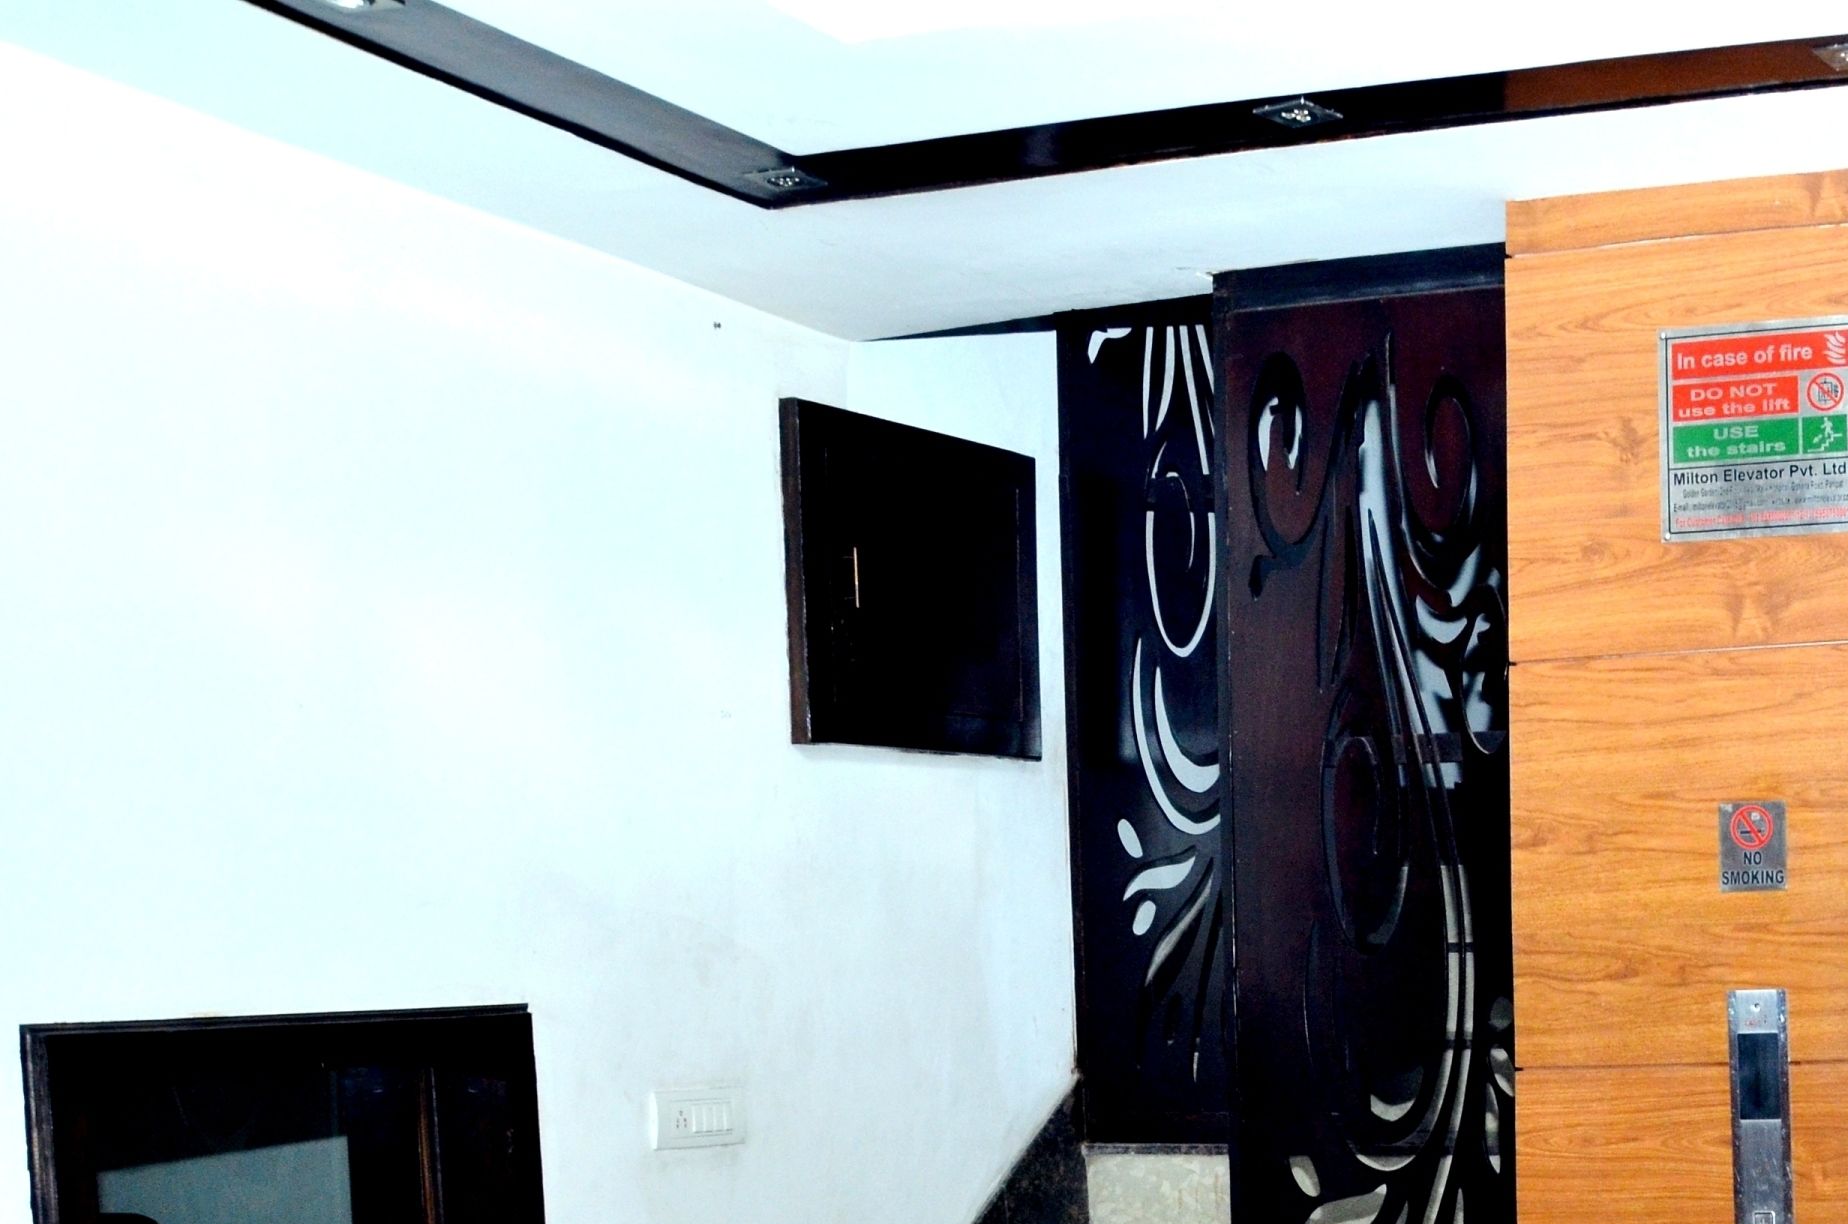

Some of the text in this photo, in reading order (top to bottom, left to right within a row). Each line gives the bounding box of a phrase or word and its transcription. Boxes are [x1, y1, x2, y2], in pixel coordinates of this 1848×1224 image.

[1677, 343, 1813, 370] In case of fire
[1690, 383, 1777, 401] DO NOT
[1678, 398, 1791, 418] use the lift
[1713, 425, 1759, 441] USE
[1686, 440, 1786, 458] the stairs
[1674, 472, 1718, 486] Milton
[1723, 468, 1784, 482] Elevator
[1790, 464, 1817, 478] Pvt.
[1743, 851, 1762, 865] NO
[1721, 870, 1785, 885] SMOKING
